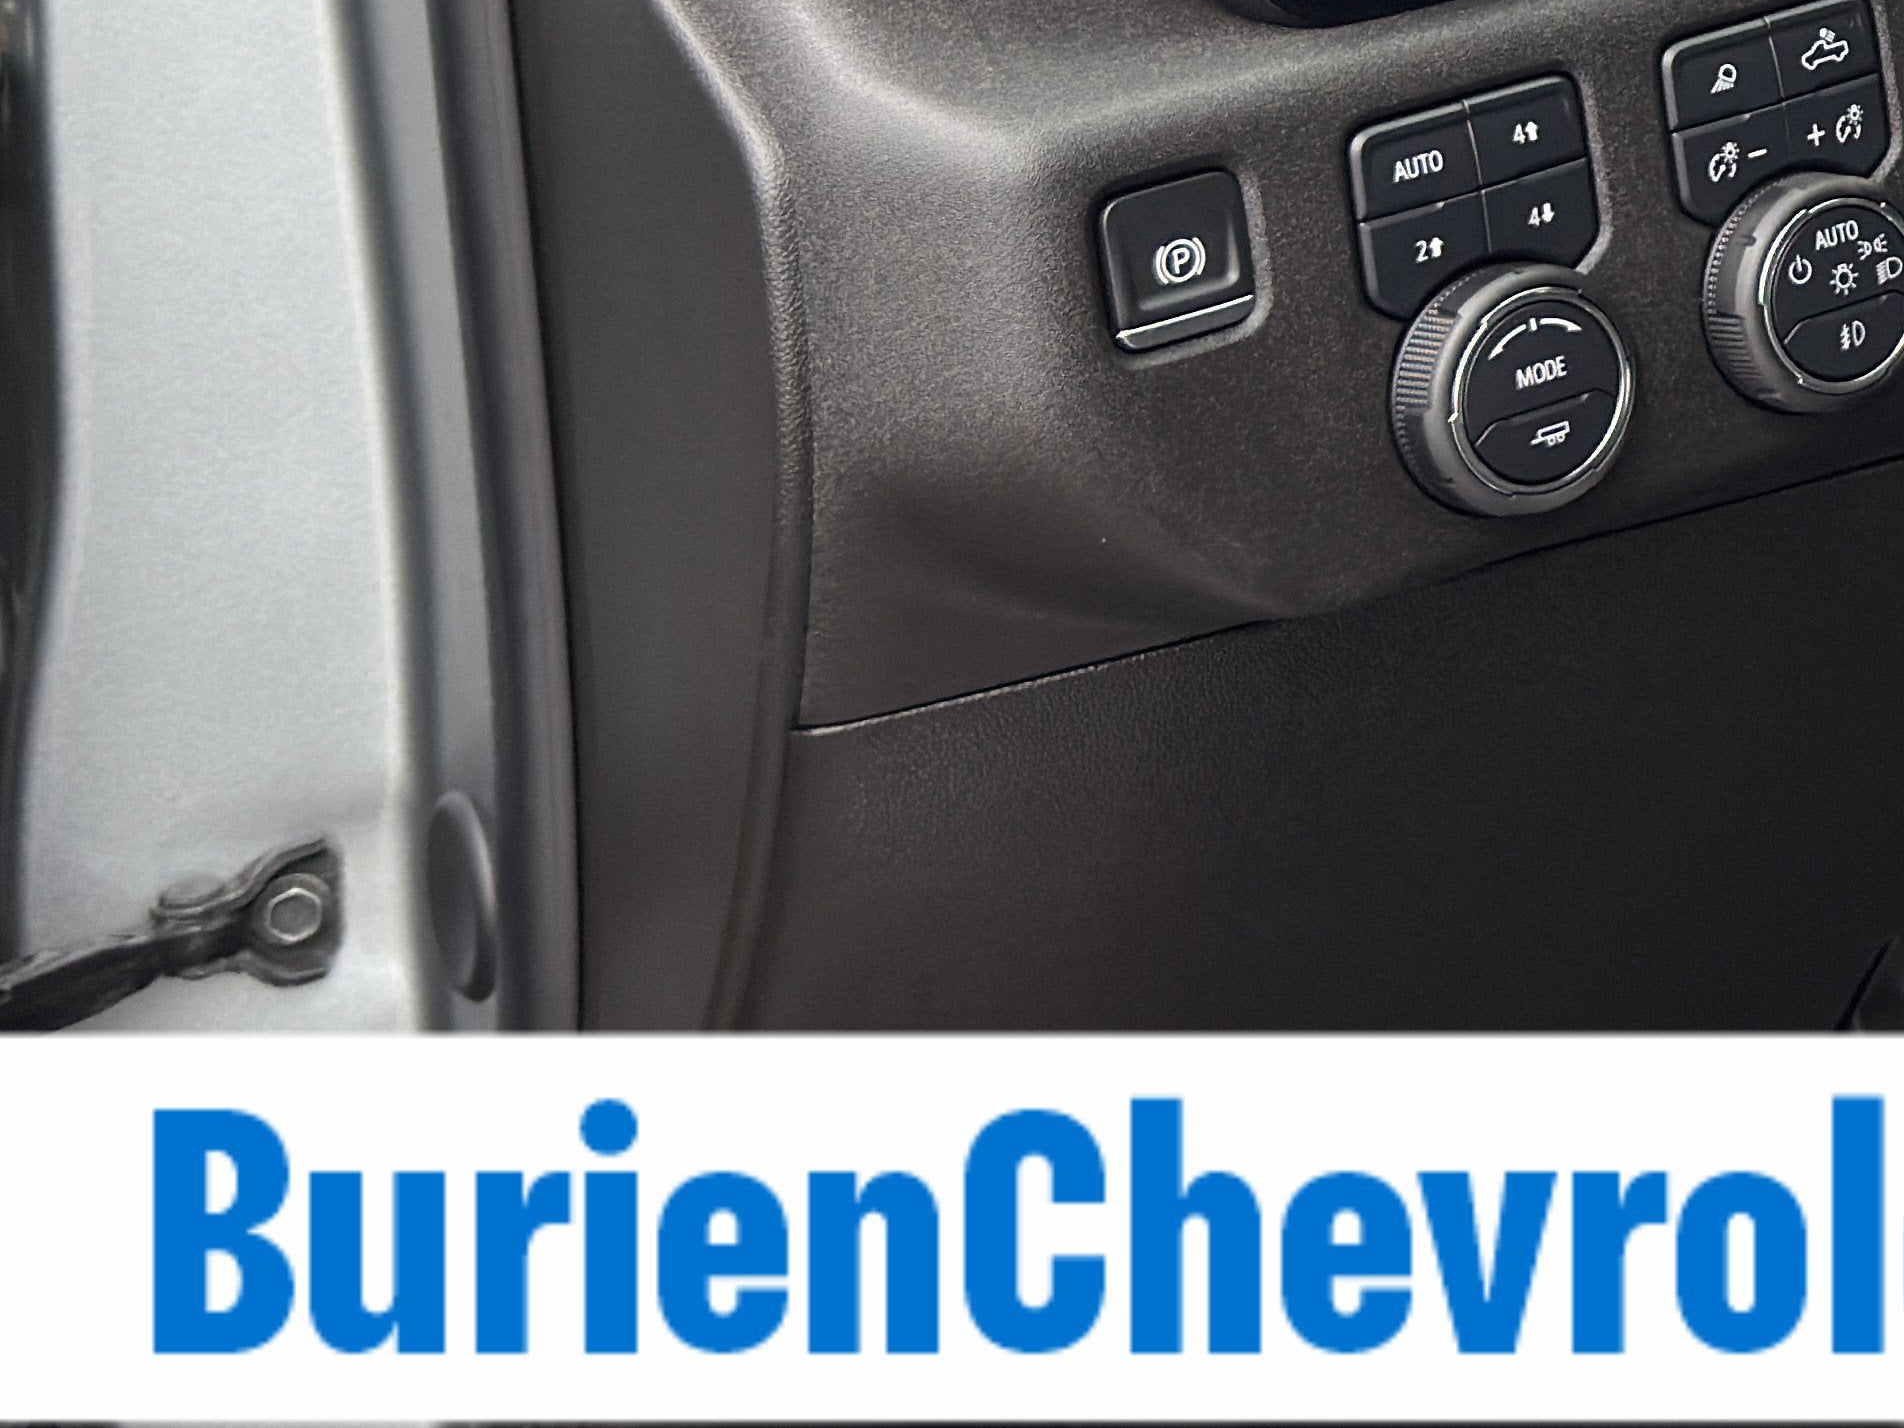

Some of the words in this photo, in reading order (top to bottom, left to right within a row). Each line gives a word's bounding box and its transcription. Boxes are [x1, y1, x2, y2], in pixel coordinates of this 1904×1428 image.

[1393, 150, 1444, 183] AUTO
[1815, 219, 1859, 250] AUTO
[1516, 355, 1567, 390] MODE
